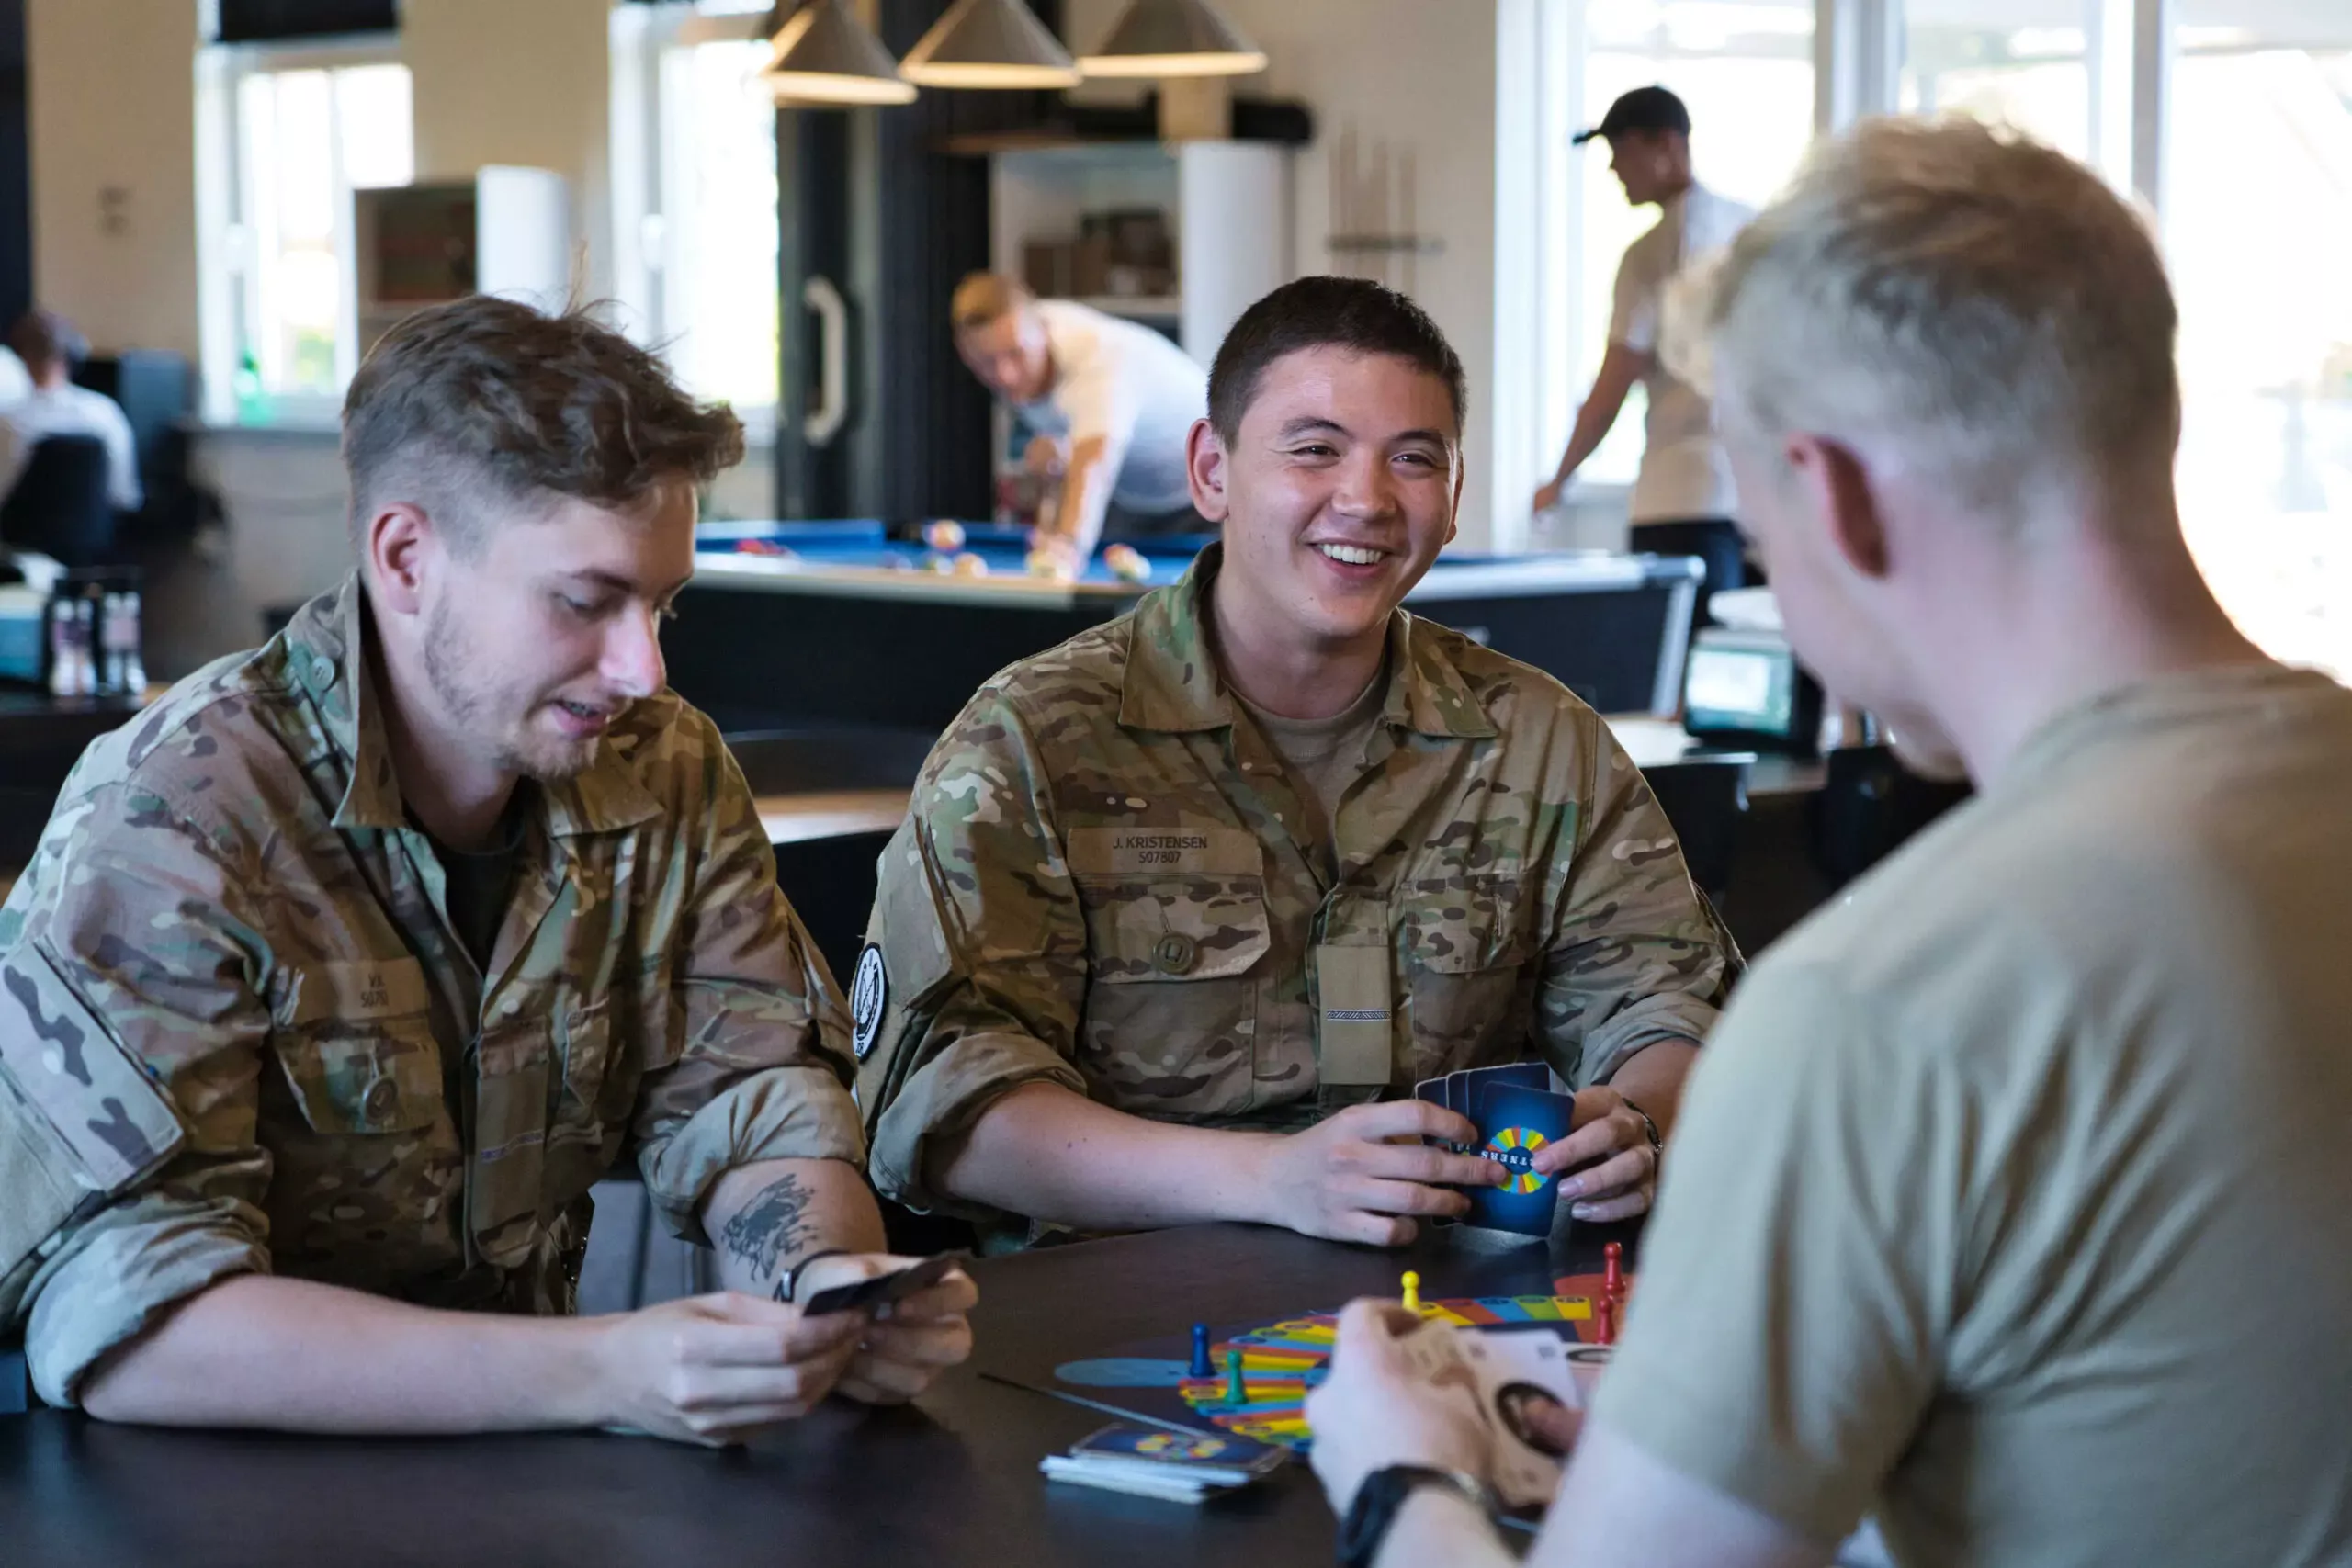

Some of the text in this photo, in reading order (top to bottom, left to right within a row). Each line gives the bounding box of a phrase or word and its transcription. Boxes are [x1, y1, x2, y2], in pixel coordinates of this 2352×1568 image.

[1113, 836, 1208, 850] J. KRISTENSEN
[1480, 1150, 1534, 1166] TNERS
